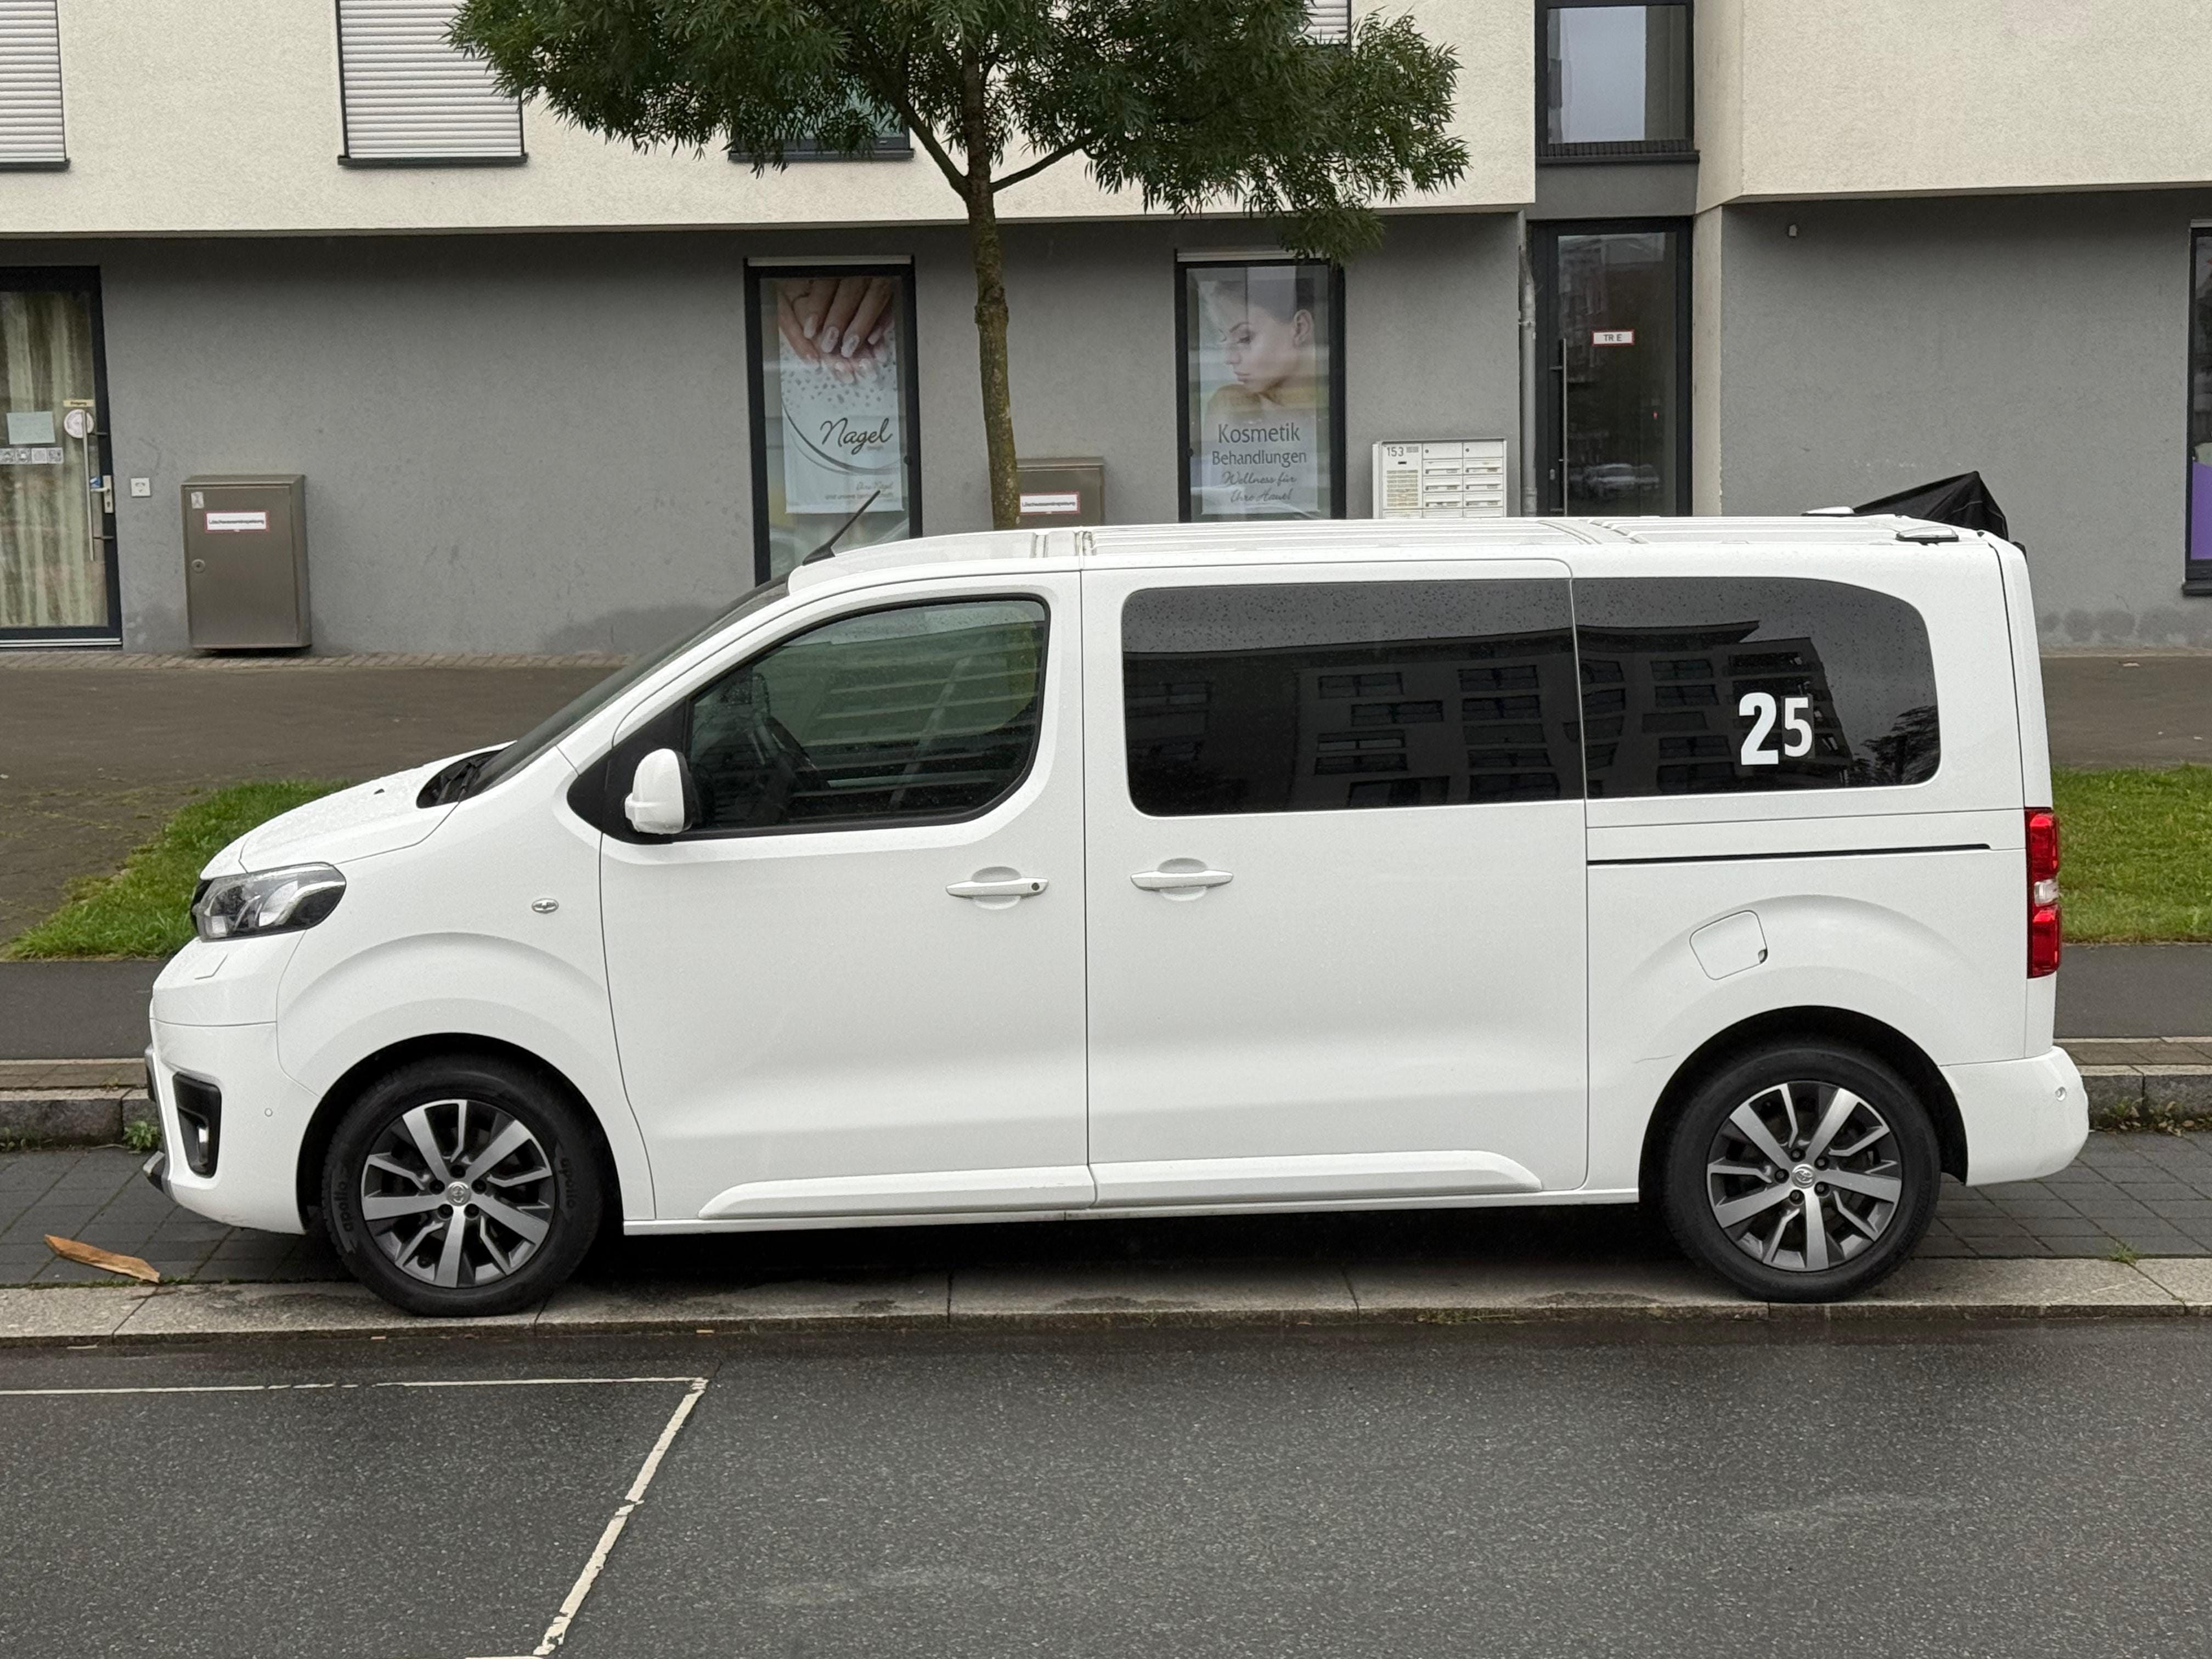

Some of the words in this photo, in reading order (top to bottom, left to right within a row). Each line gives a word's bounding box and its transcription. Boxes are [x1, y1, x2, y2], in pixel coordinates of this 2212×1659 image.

[1604, 334, 1615, 342] TR
[1616, 334, 1622, 342] E
[820, 417, 893, 455] Nagel
[1218, 422, 1301, 443] Kosmetik
[1212, 450, 1307, 468] Behandlungen
[1386, 446, 1404, 457] 153
[1222, 471, 1276, 485] Wellness
[1277, 471, 1297, 487] für
[1739, 692, 1813, 766] 25
[332, 1181, 354, 1232] apollo
